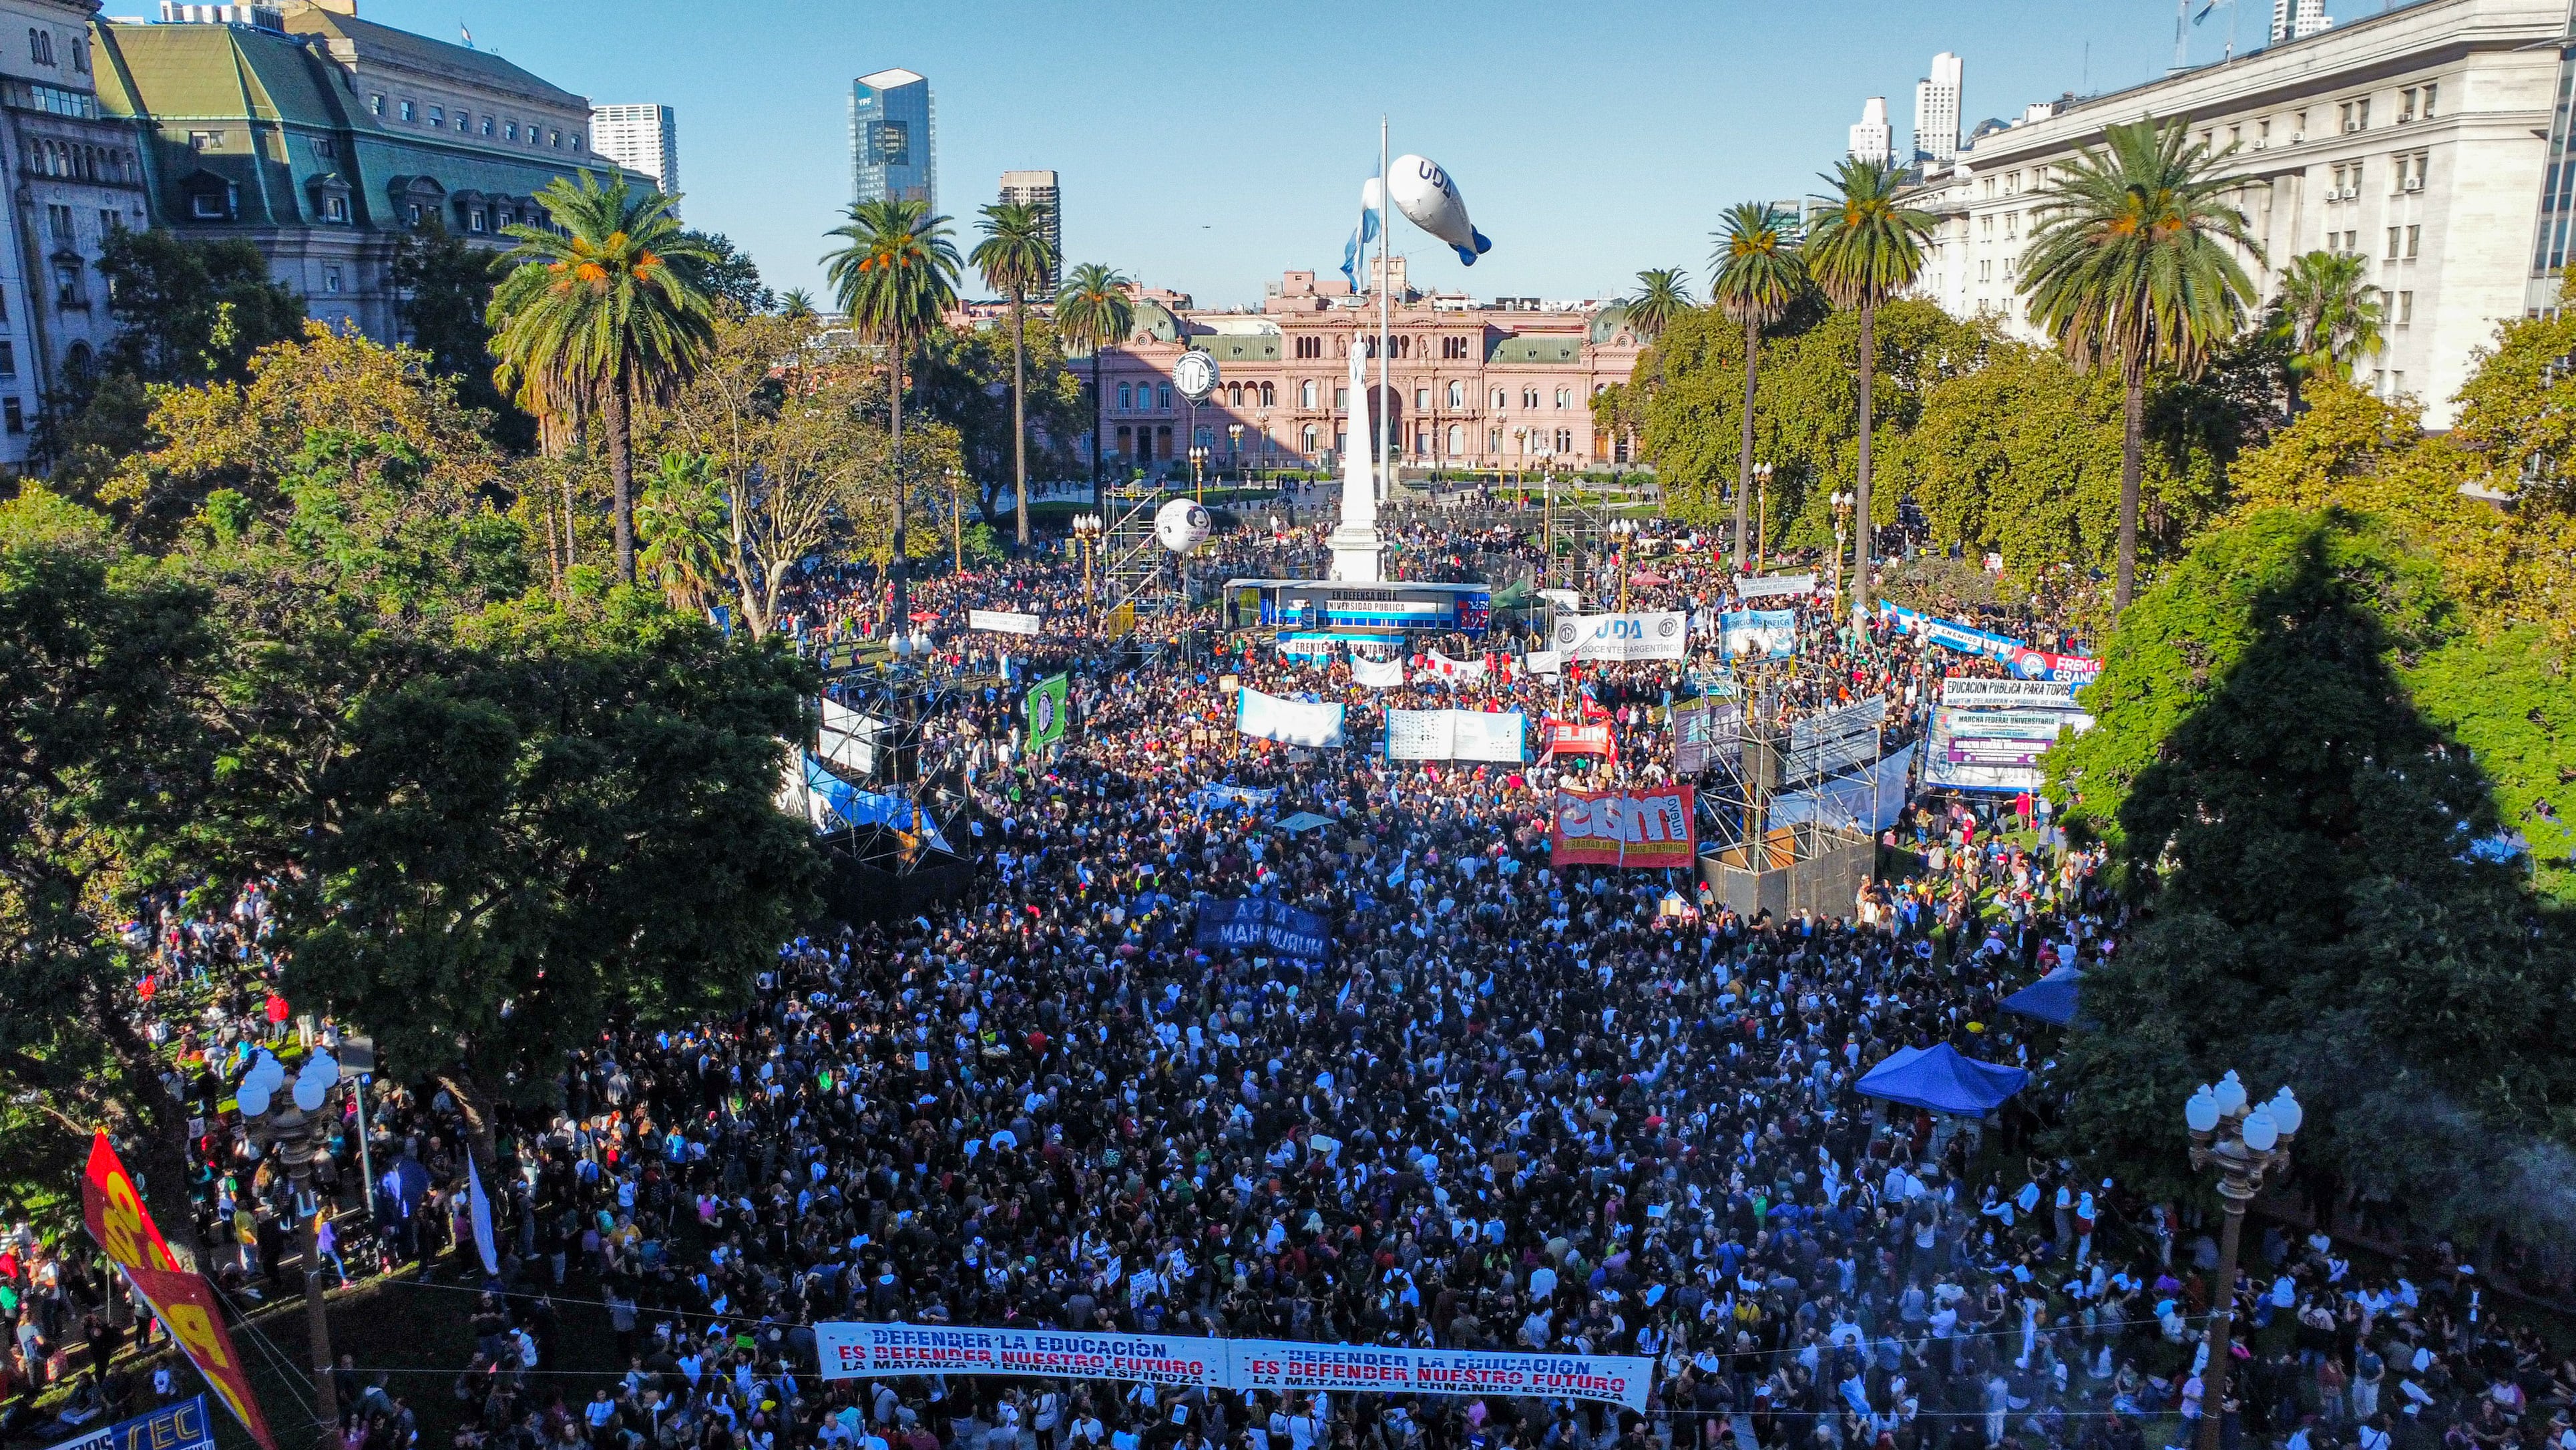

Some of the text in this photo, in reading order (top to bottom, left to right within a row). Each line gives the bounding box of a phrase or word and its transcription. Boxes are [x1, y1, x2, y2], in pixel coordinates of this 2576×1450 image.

[858, 98, 871, 106] YPF
[1419, 160, 1452, 199] UDA
[1332, 591, 1397, 601] EN DEFENSA DE LA
[1324, 601, 1372, 610] UNIVERSIDAD
[1596, 619, 1643, 640] UDA
[1939, 620, 1961, 631] AMIGO
[1963, 627, 1980, 636] TODO
[1295, 642, 1325, 653] FRENTE
[1582, 645, 1628, 655] DOCENTES
[1629, 643, 1681, 654] ARGENTINOS
[1936, 635, 1964, 649] JUSTICIA
[2057, 657, 2101, 671] FRENTE
[1947, 681, 1988, 694] EDUCACION
[2023, 683, 2045, 695] PARA
[2047, 683, 2071, 696] TODOS
[1985, 716, 2008, 724] FEDERAL
[2010, 717, 2055, 725] UNIVERSITARIA
[872, 1329, 992, 1348] DEFENDER
[1000, 1334, 1028, 1350] LA
[839, 1346, 1204, 1376] ES DEFENDER NUESTRO FUTURO
[1289, 1350, 1410, 1367] DEFENDER
[1418, 1356, 1446, 1369] LA
[841, 1361, 1205, 1385] LA MATANZA FERNANDO ESPINOZA
[1253, 1361, 1626, 1393] ES DEFENDER NUESTRO FUTURO
[1253, 1376, 1625, 1402] LA MATANZA FERNANDO ESPINOZA
